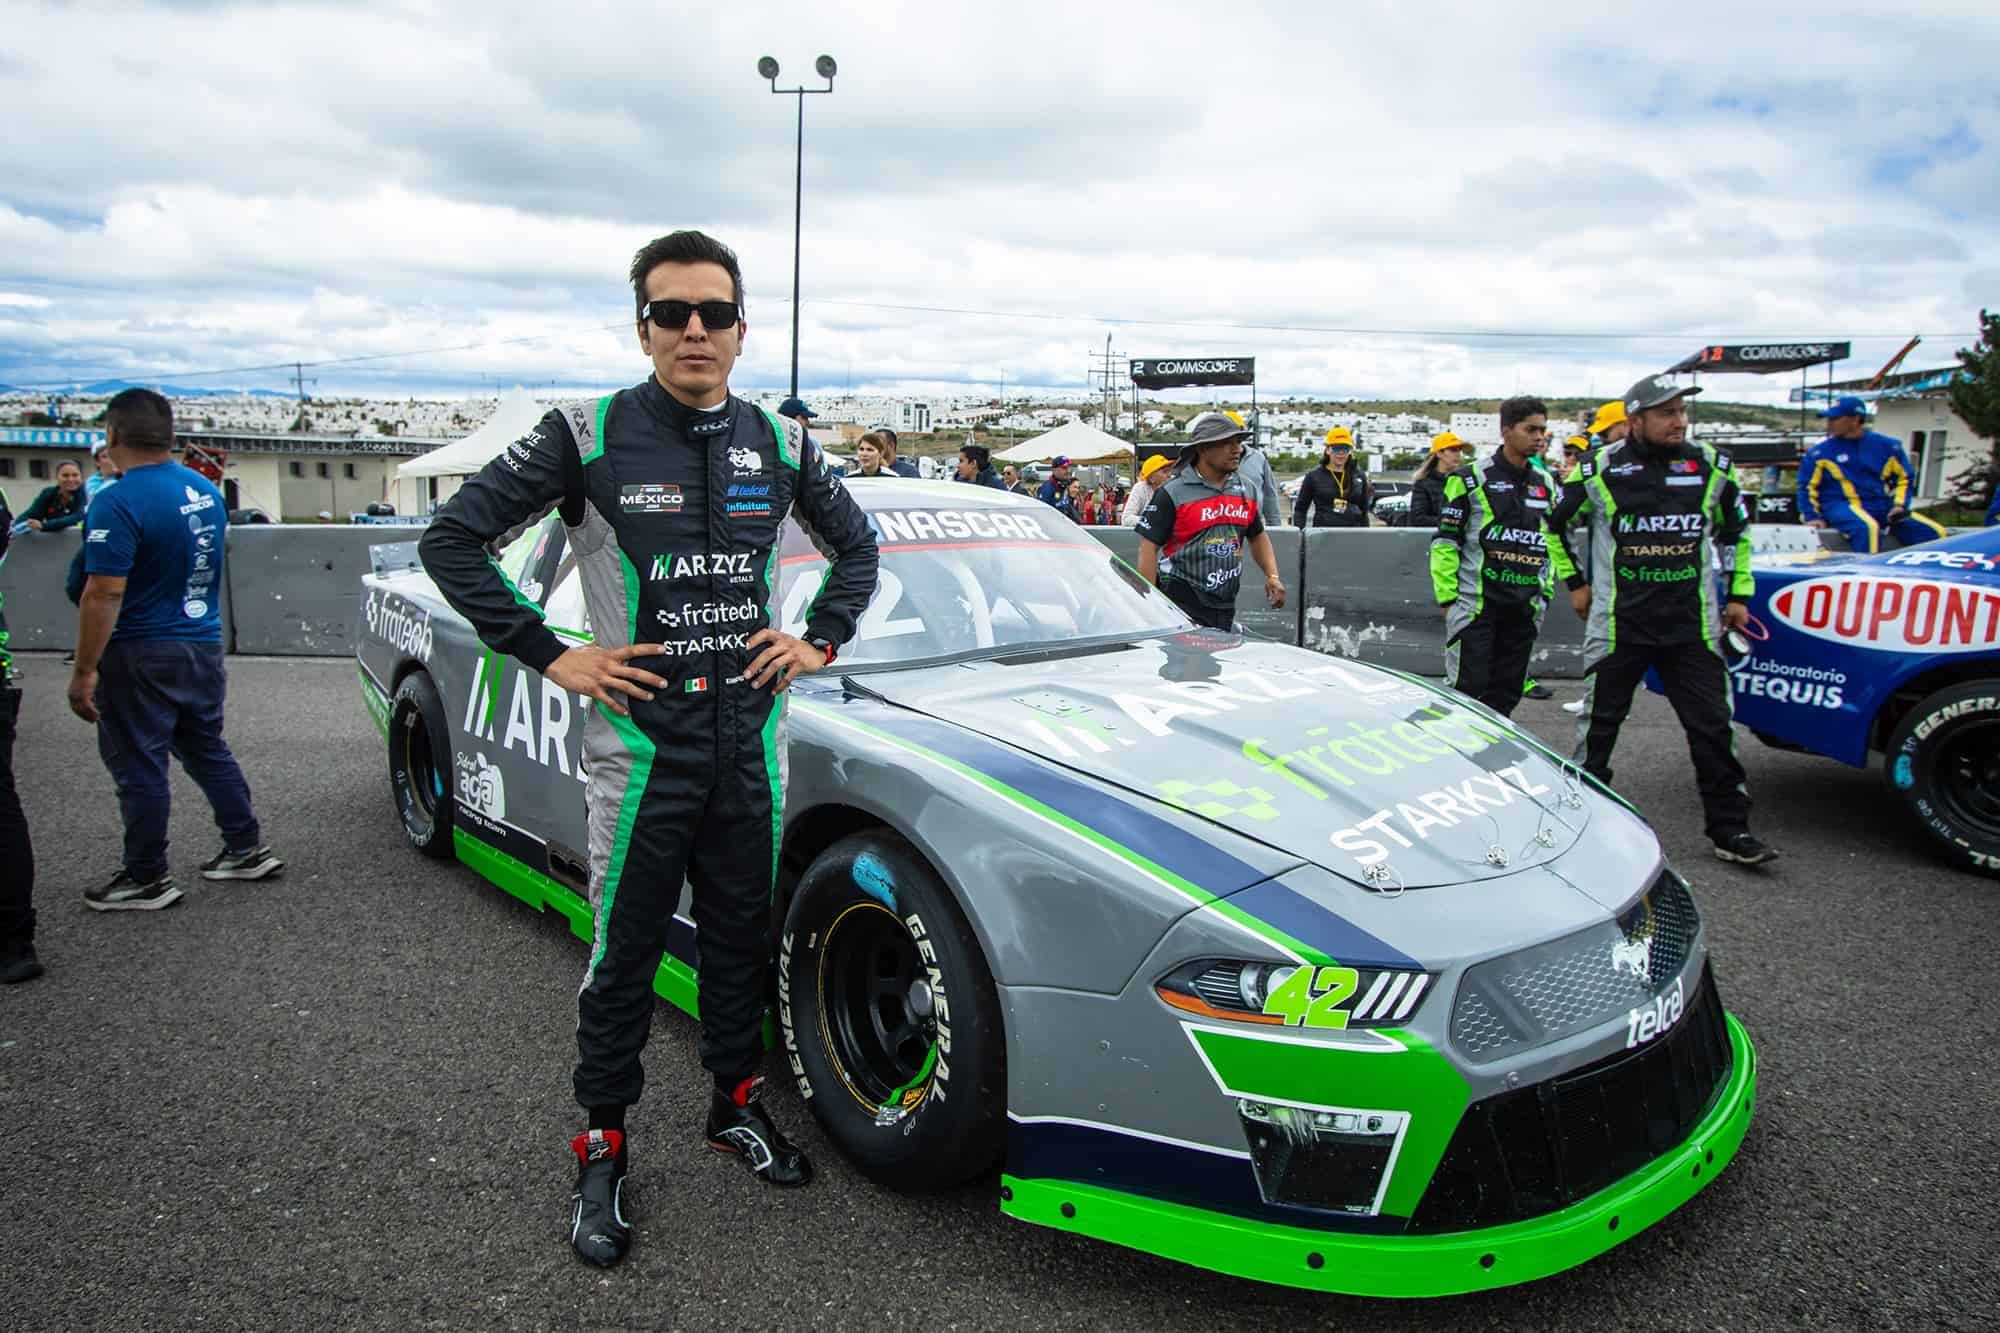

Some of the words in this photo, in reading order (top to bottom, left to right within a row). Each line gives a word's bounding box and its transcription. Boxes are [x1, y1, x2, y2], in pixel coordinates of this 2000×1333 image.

[1156, 360, 1237, 375] COMMSCOPE
[1739, 344, 1833, 360] COMMSCOPE
[620, 493, 683, 505] MÉXICO
[738, 484, 769, 496] telcel
[875, 512, 1049, 541] NASCAR
[1803, 581, 2000, 646] DUPONT
[1751, 657, 1847, 684] Laboratorio
[1734, 672, 1844, 709] TEQUIS
[1913, 696, 2000, 740] GENER
[905, 913, 952, 1102] GENERAL
[1262, 966, 1359, 1030] 42
[1625, 977, 1685, 1049] telcel
